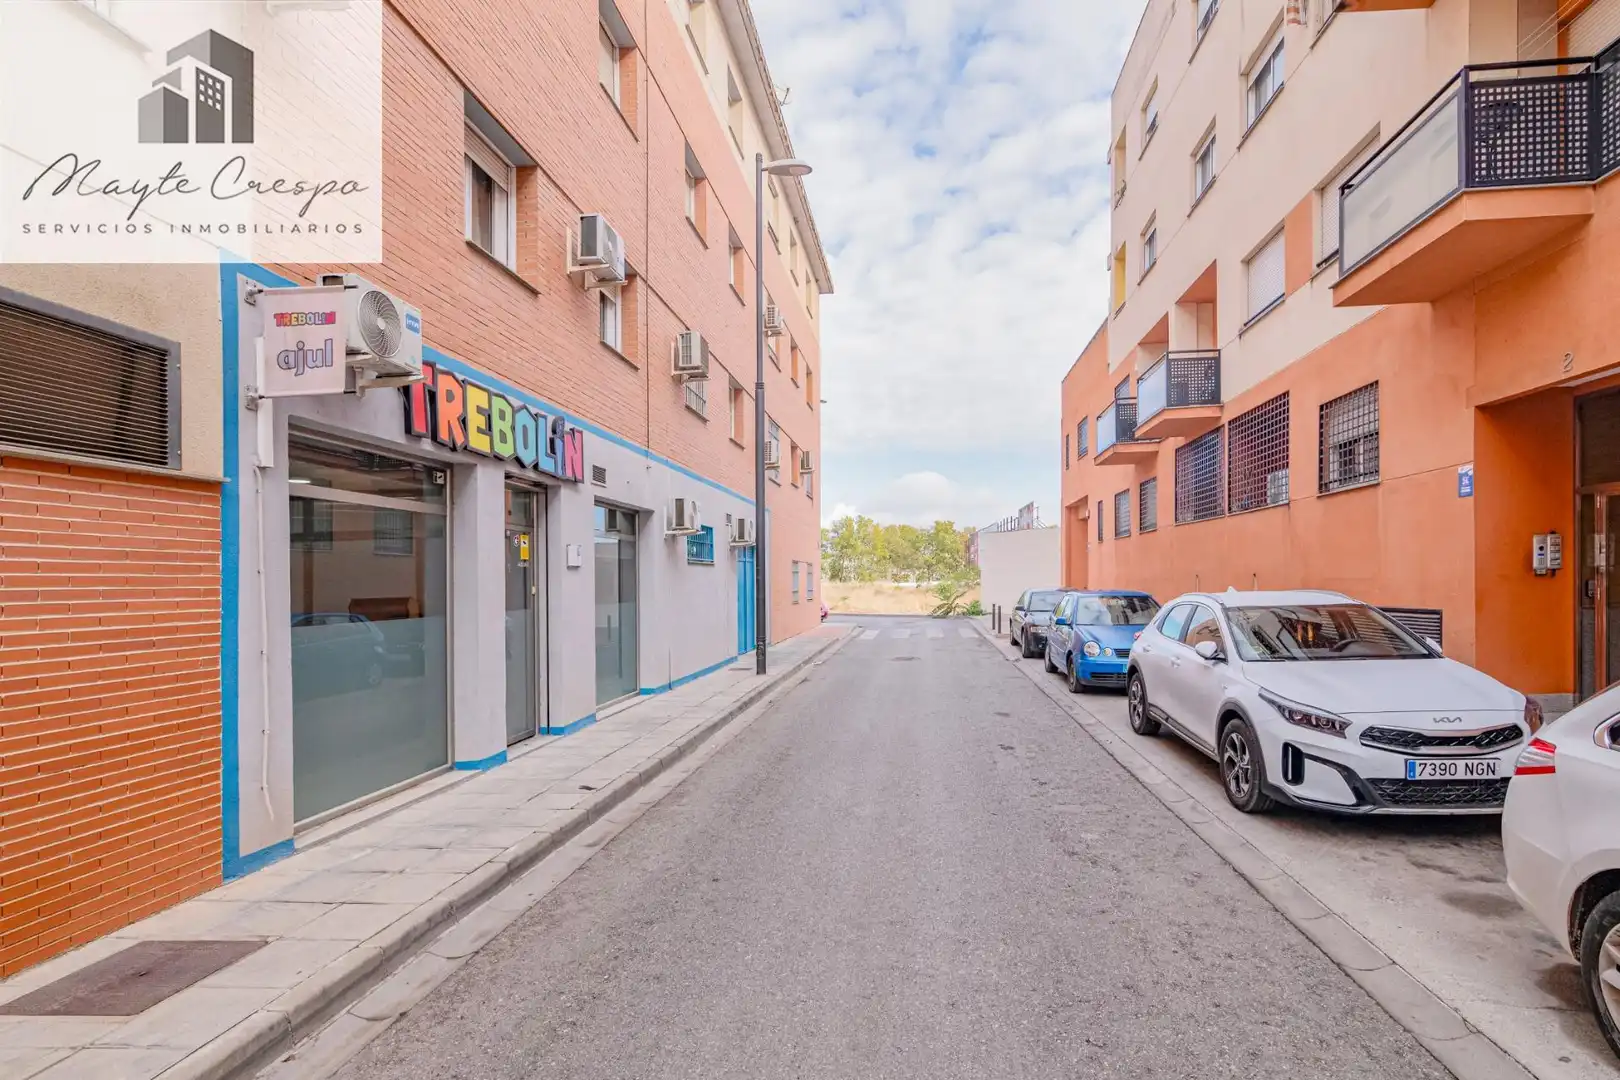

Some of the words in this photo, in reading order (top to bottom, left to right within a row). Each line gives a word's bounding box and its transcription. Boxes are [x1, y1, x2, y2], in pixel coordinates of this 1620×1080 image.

[276, 338, 334, 377] ajul
[1562, 351, 1574, 373] 2
[1418, 762, 1458, 777] 7390
[1464, 762, 1497, 777] NGN
